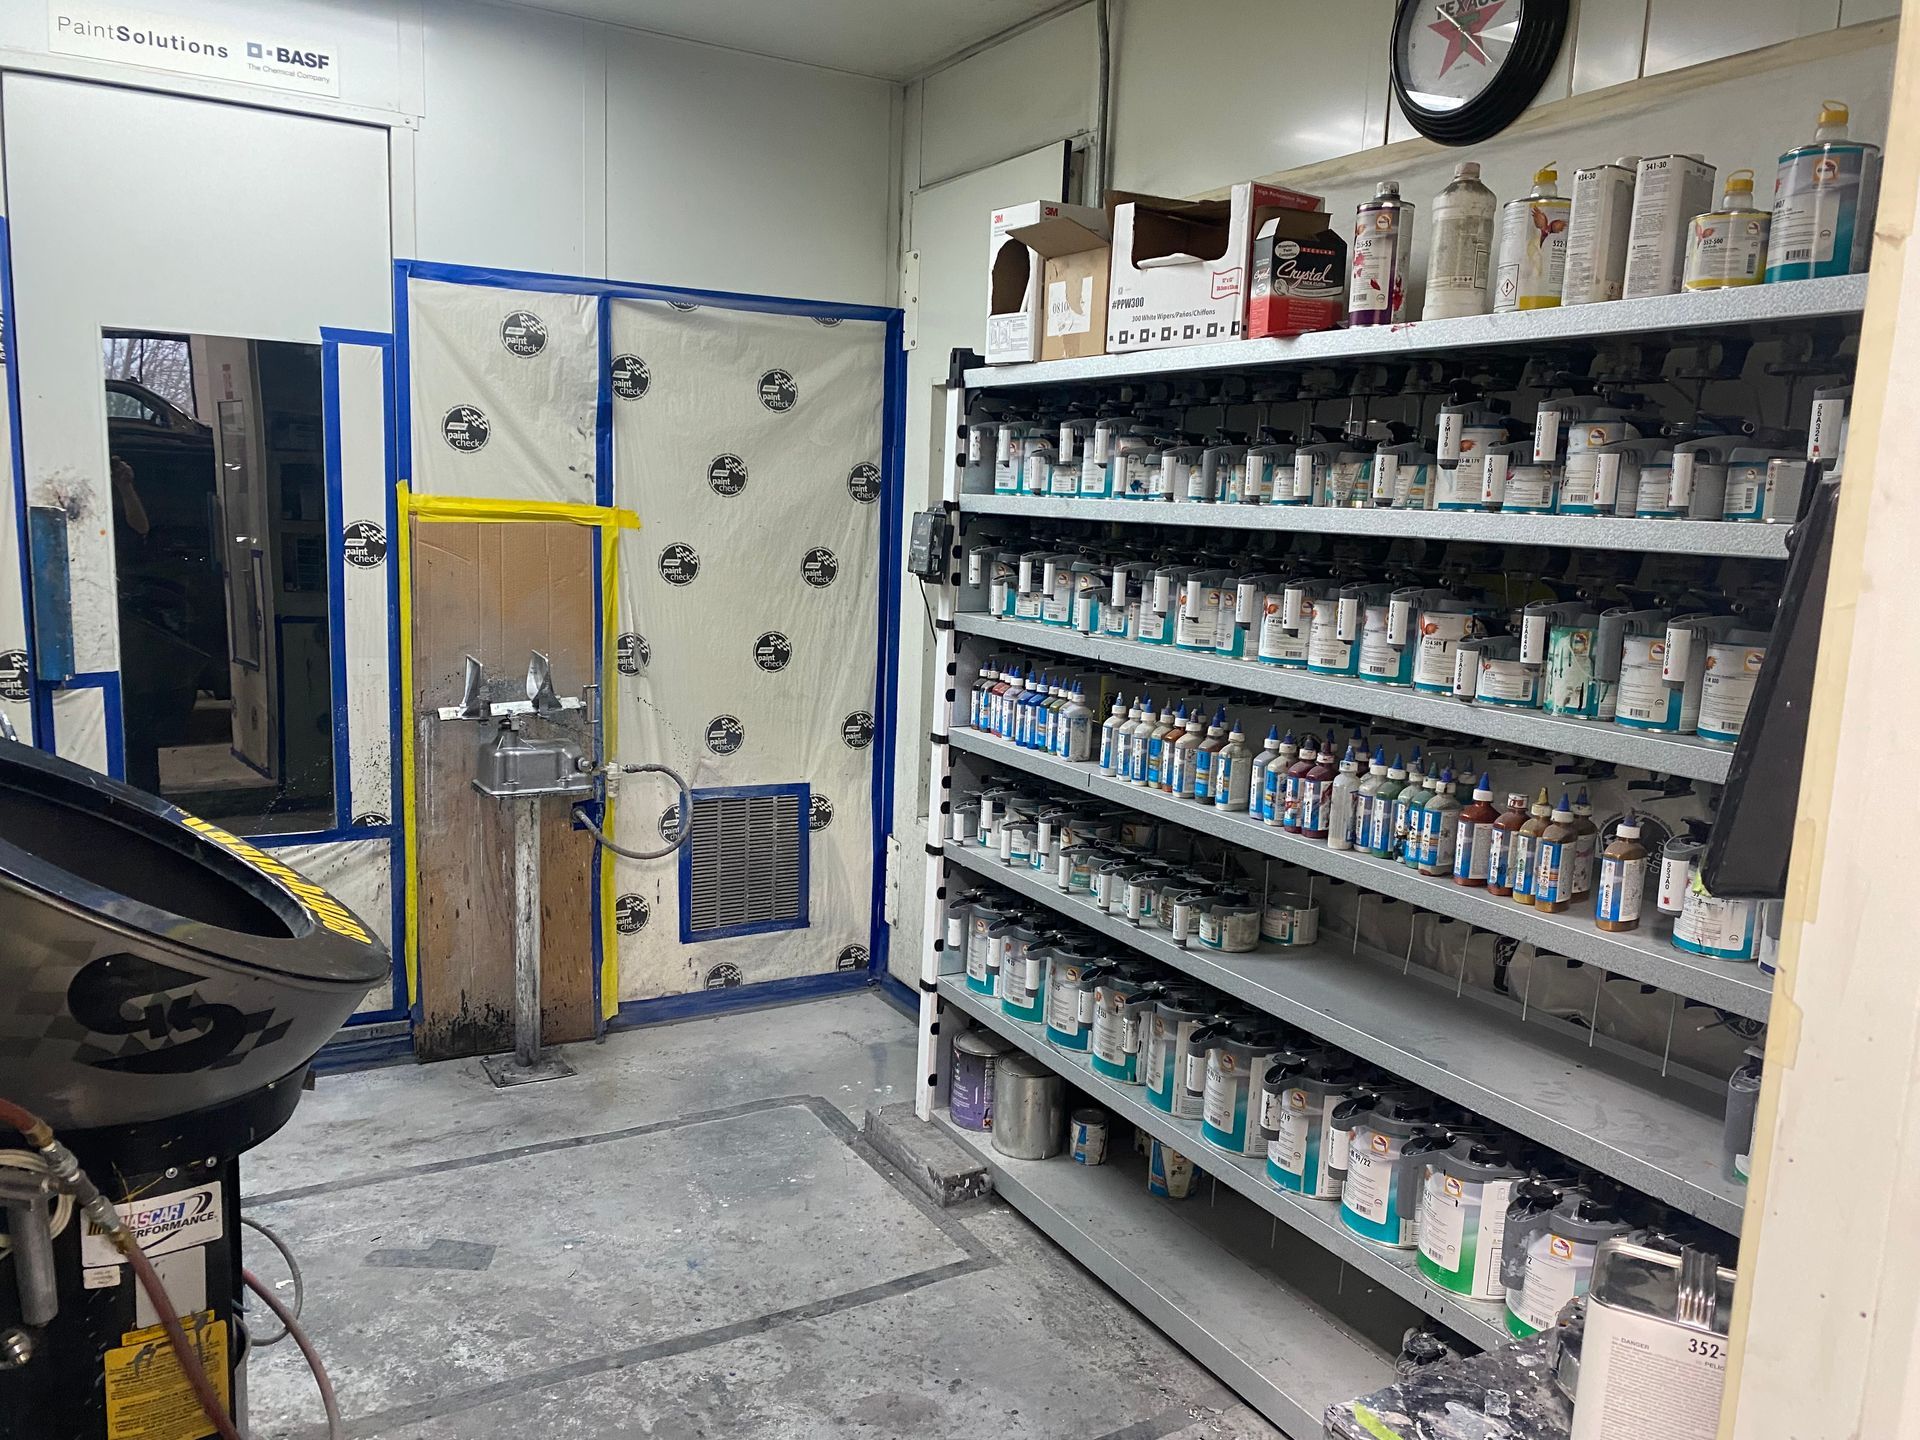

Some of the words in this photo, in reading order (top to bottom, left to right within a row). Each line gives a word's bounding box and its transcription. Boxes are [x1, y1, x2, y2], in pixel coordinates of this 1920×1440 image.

[57, 16, 229, 59] PaintSolutions
[277, 47, 330, 70] BASF
[247, 63, 261, 71] The
[262, 65, 295, 78] Chemical
[297, 70, 330, 84] Company
[1044, 207, 1058, 217] 3M
[994, 214, 1004, 224] 3M
[1276, 260, 1333, 289] Crystal
[1112, 297, 1145, 310] #PPW300
[1142, 313, 1156, 321] White
[506, 336, 527, 345] paint
[513, 343, 537, 352] check
[612, 379, 632, 388] paint
[620, 386, 640, 395] check
[762, 393, 780, 402] paint
[769, 399, 789, 407] check
[448, 431, 469, 440] paint
[455, 438, 480, 447] check
[712, 477, 730, 486] paint
[719, 484, 739, 492] check
[851, 485, 867, 494] paint
[856, 491, 875, 499] check
[345, 546, 368, 556] paint
[354, 554, 379, 563] check
[663, 566, 682, 575] paint
[805, 569, 822, 577] paint
[670, 573, 690, 581] check
[758, 653, 775, 662] paint
[764, 659, 783, 667] check
[0, 679, 22, 688] aint
[5, 686, 29, 696] chec
[846, 732, 861, 741] paint
[852, 737, 868, 745] check
[710, 737, 727, 746] paint
[716, 743, 736, 751] check
[620, 922, 641, 930] check
[133, 1211, 215, 1240] ERFORMANCE
[1621, 1337, 1650, 1351] DANGER
[1688, 1338, 1726, 1359] 352-
